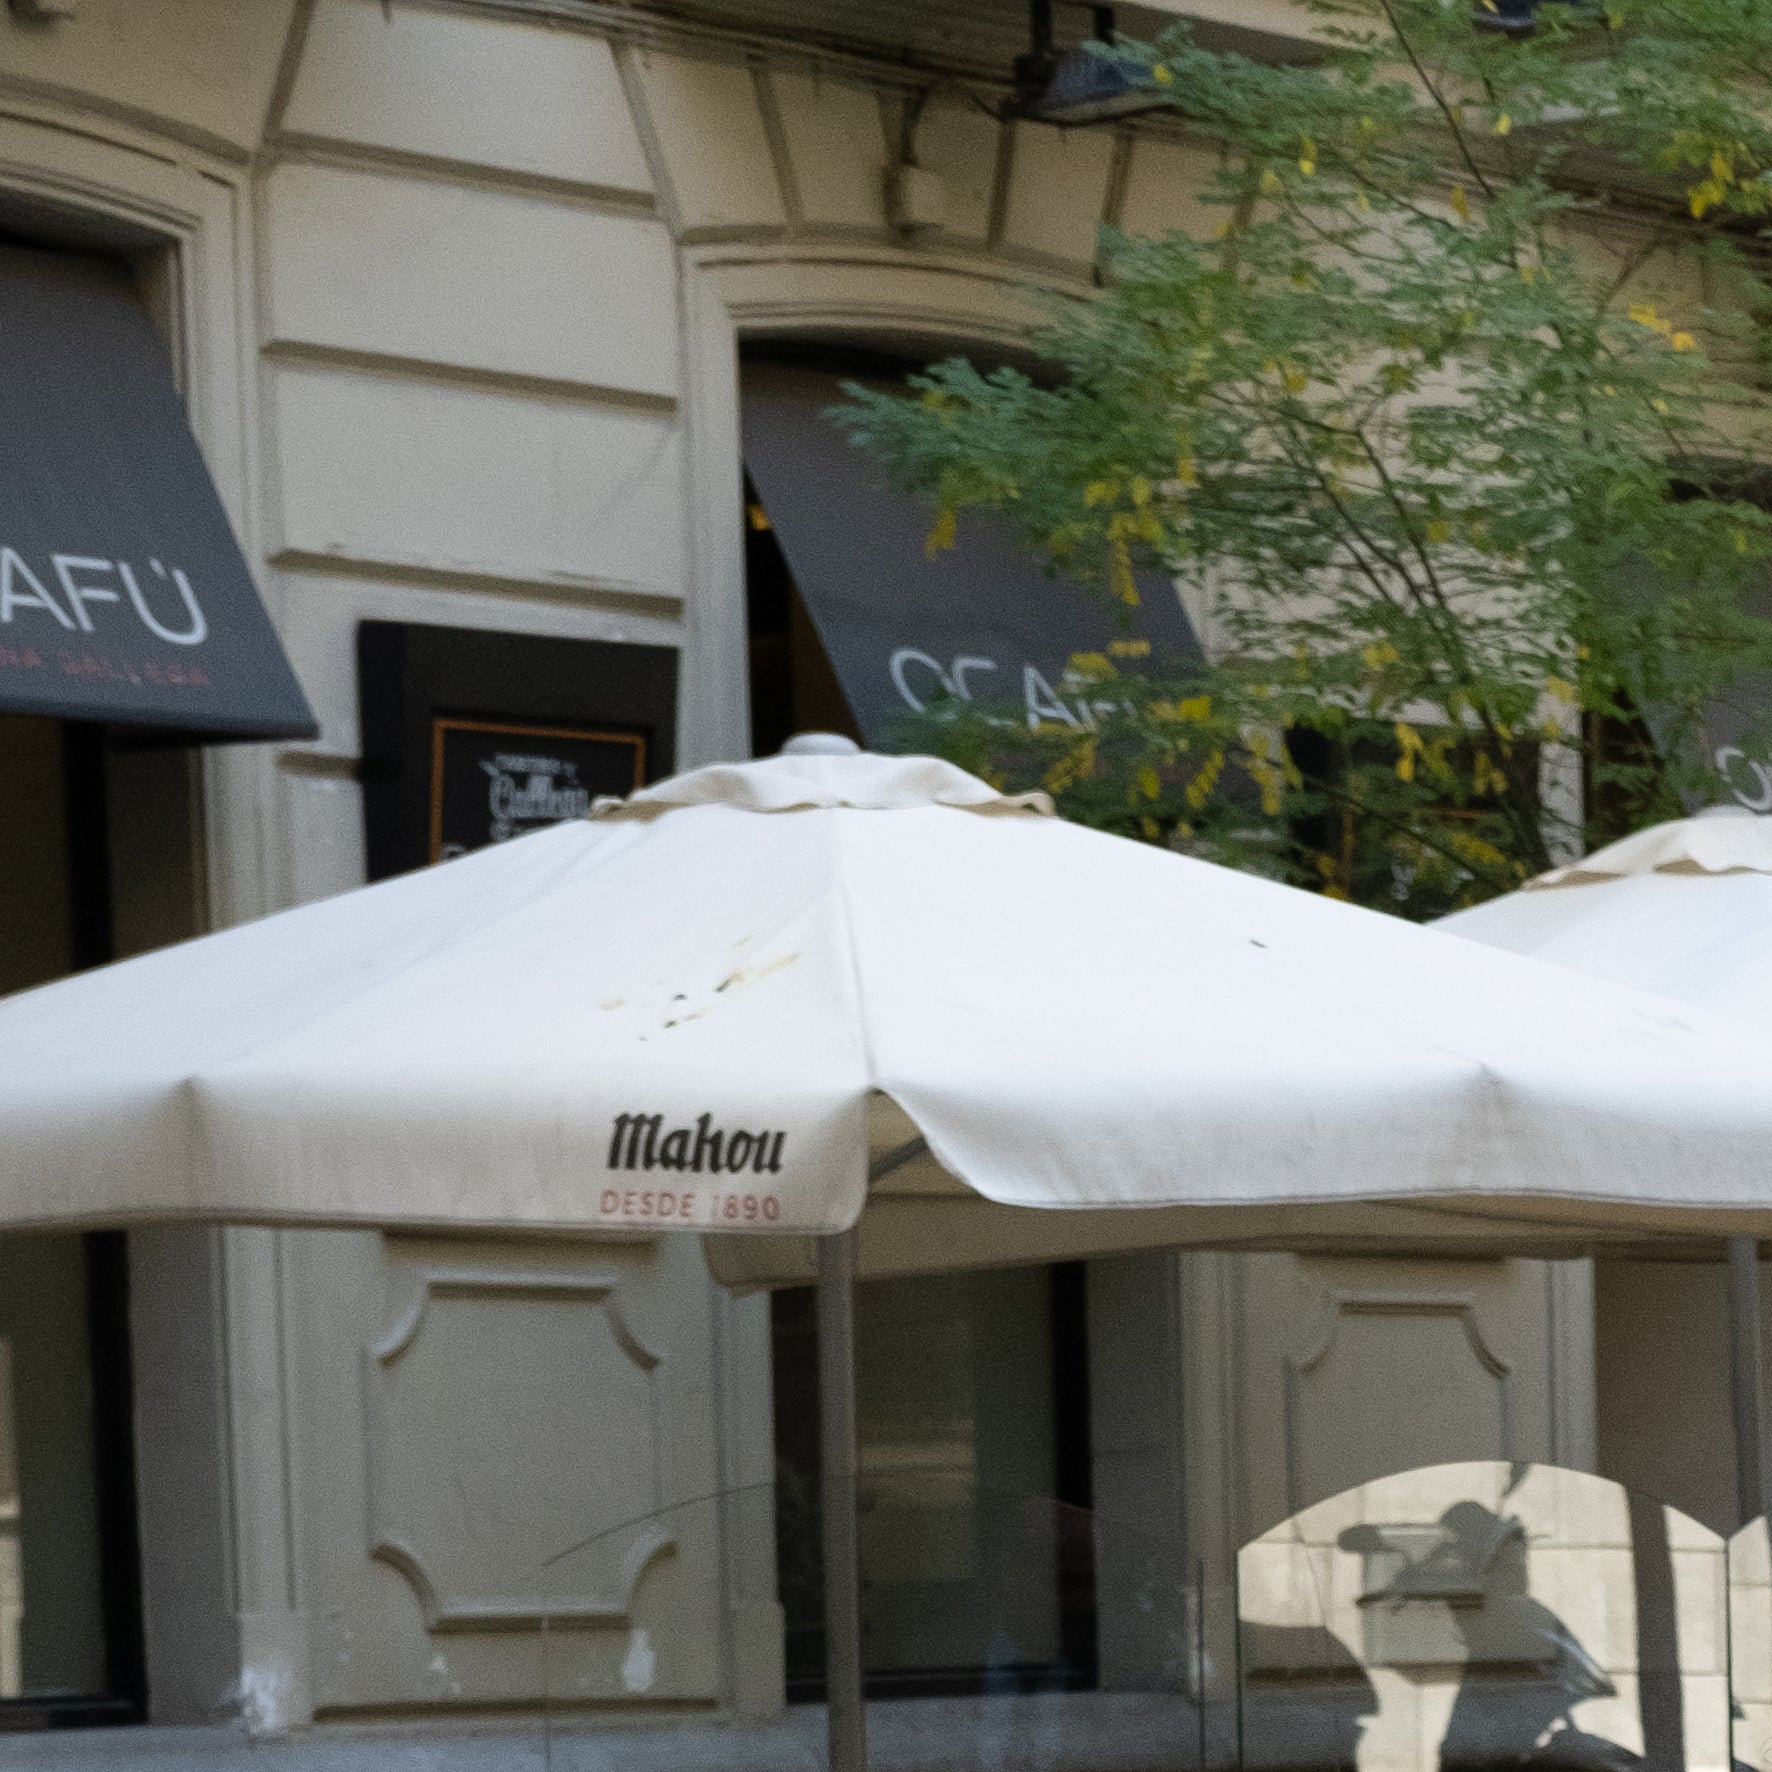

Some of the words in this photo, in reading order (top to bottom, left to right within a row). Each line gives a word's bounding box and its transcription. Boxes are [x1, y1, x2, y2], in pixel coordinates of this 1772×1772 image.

[608, 1112, 786, 1173] Mahou
[600, 1189, 695, 1217] DESDE
[711, 1194, 780, 1221] 1890
